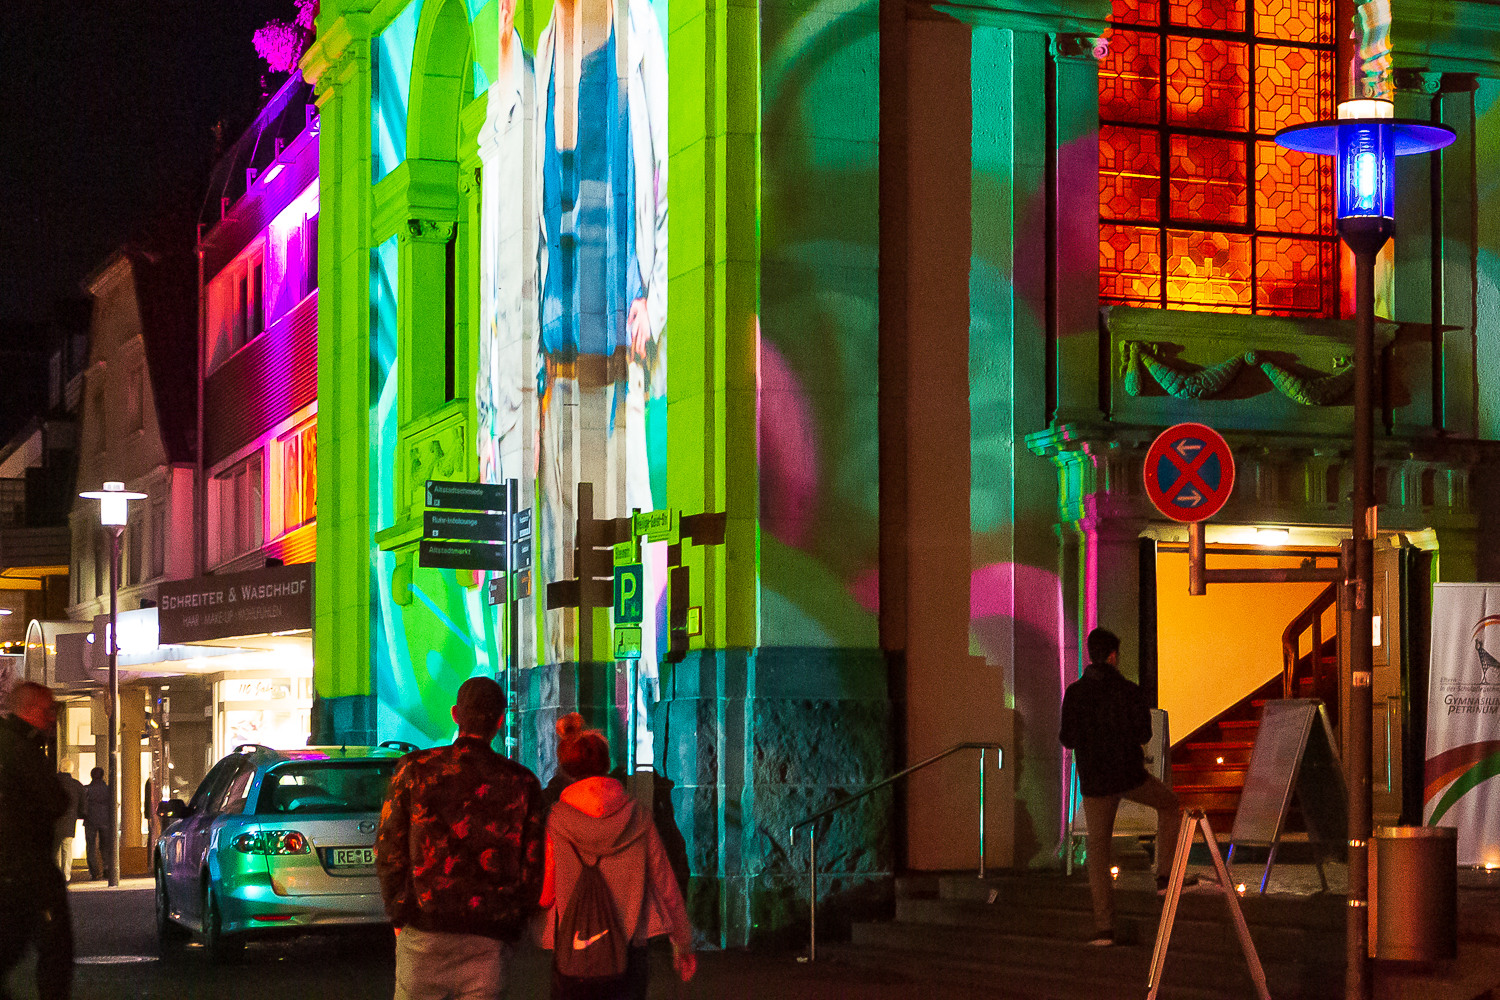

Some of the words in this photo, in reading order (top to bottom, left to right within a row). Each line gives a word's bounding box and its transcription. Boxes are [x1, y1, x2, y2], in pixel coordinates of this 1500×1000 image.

[428, 545, 472, 556] Altstadtmarkt
[228, 587, 237, 602] &
[620, 572, 637, 617] P
[1447, 705, 1499, 716] PETRINUM
[337, 850, 355, 864] RE
